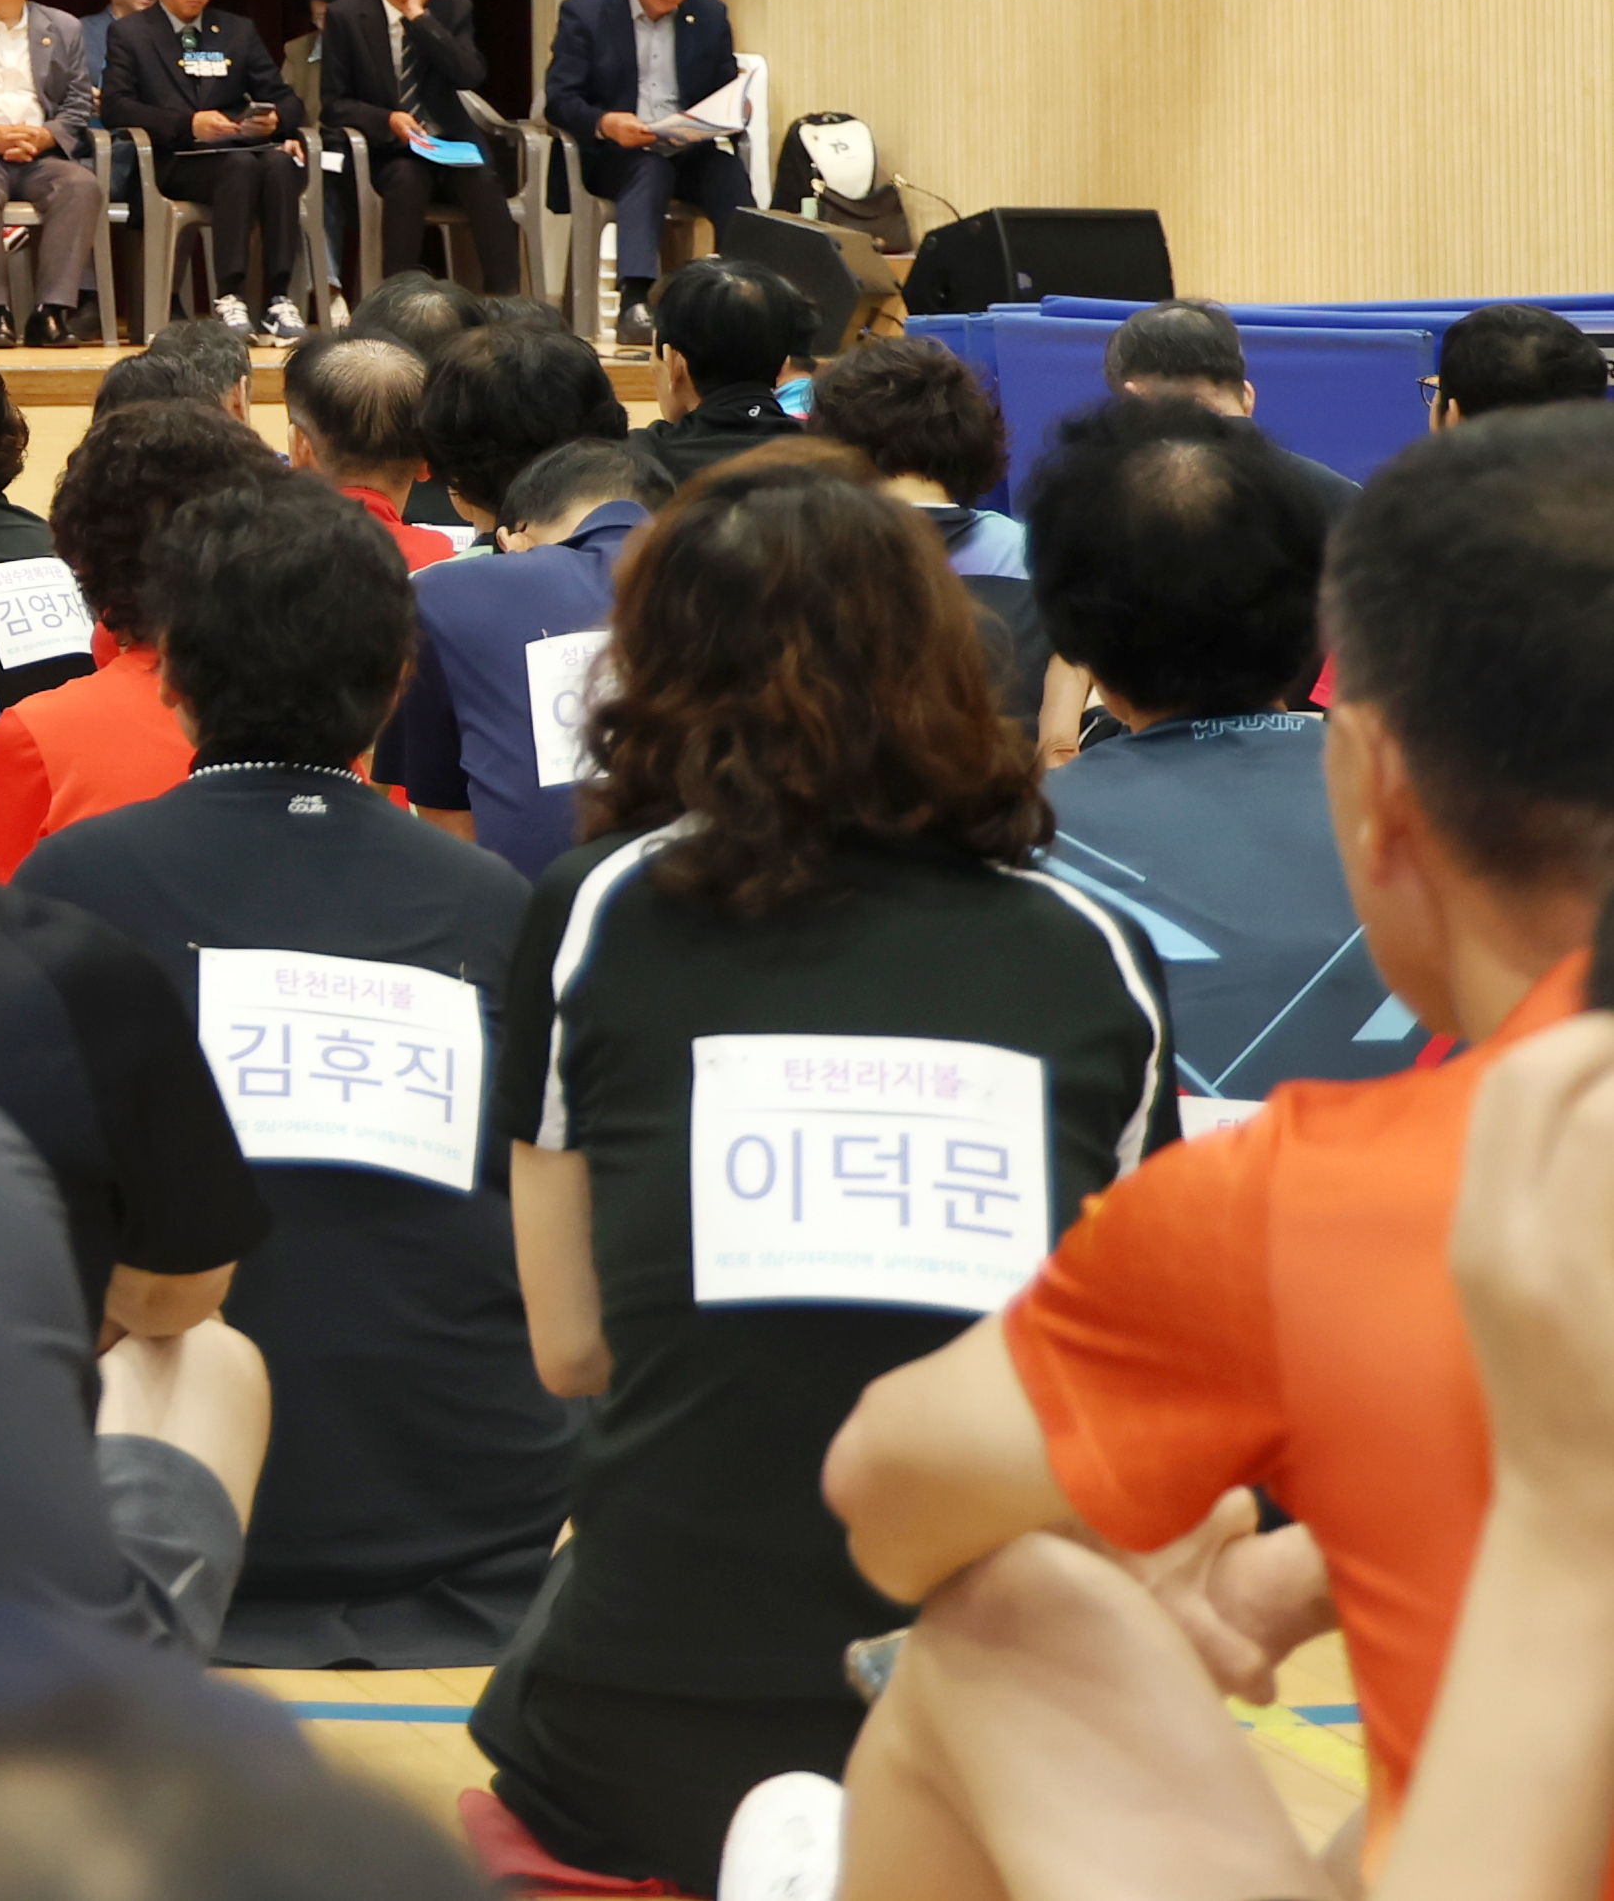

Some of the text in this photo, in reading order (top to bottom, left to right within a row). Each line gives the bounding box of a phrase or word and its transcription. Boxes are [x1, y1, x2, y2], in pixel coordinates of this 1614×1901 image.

[275, 968, 416, 1010] 탄천라지볼
[228, 1023, 455, 1124] 김후직
[784, 1058, 966, 1100] 탄천라지볼
[725, 1128, 1021, 1239] 이덕문
